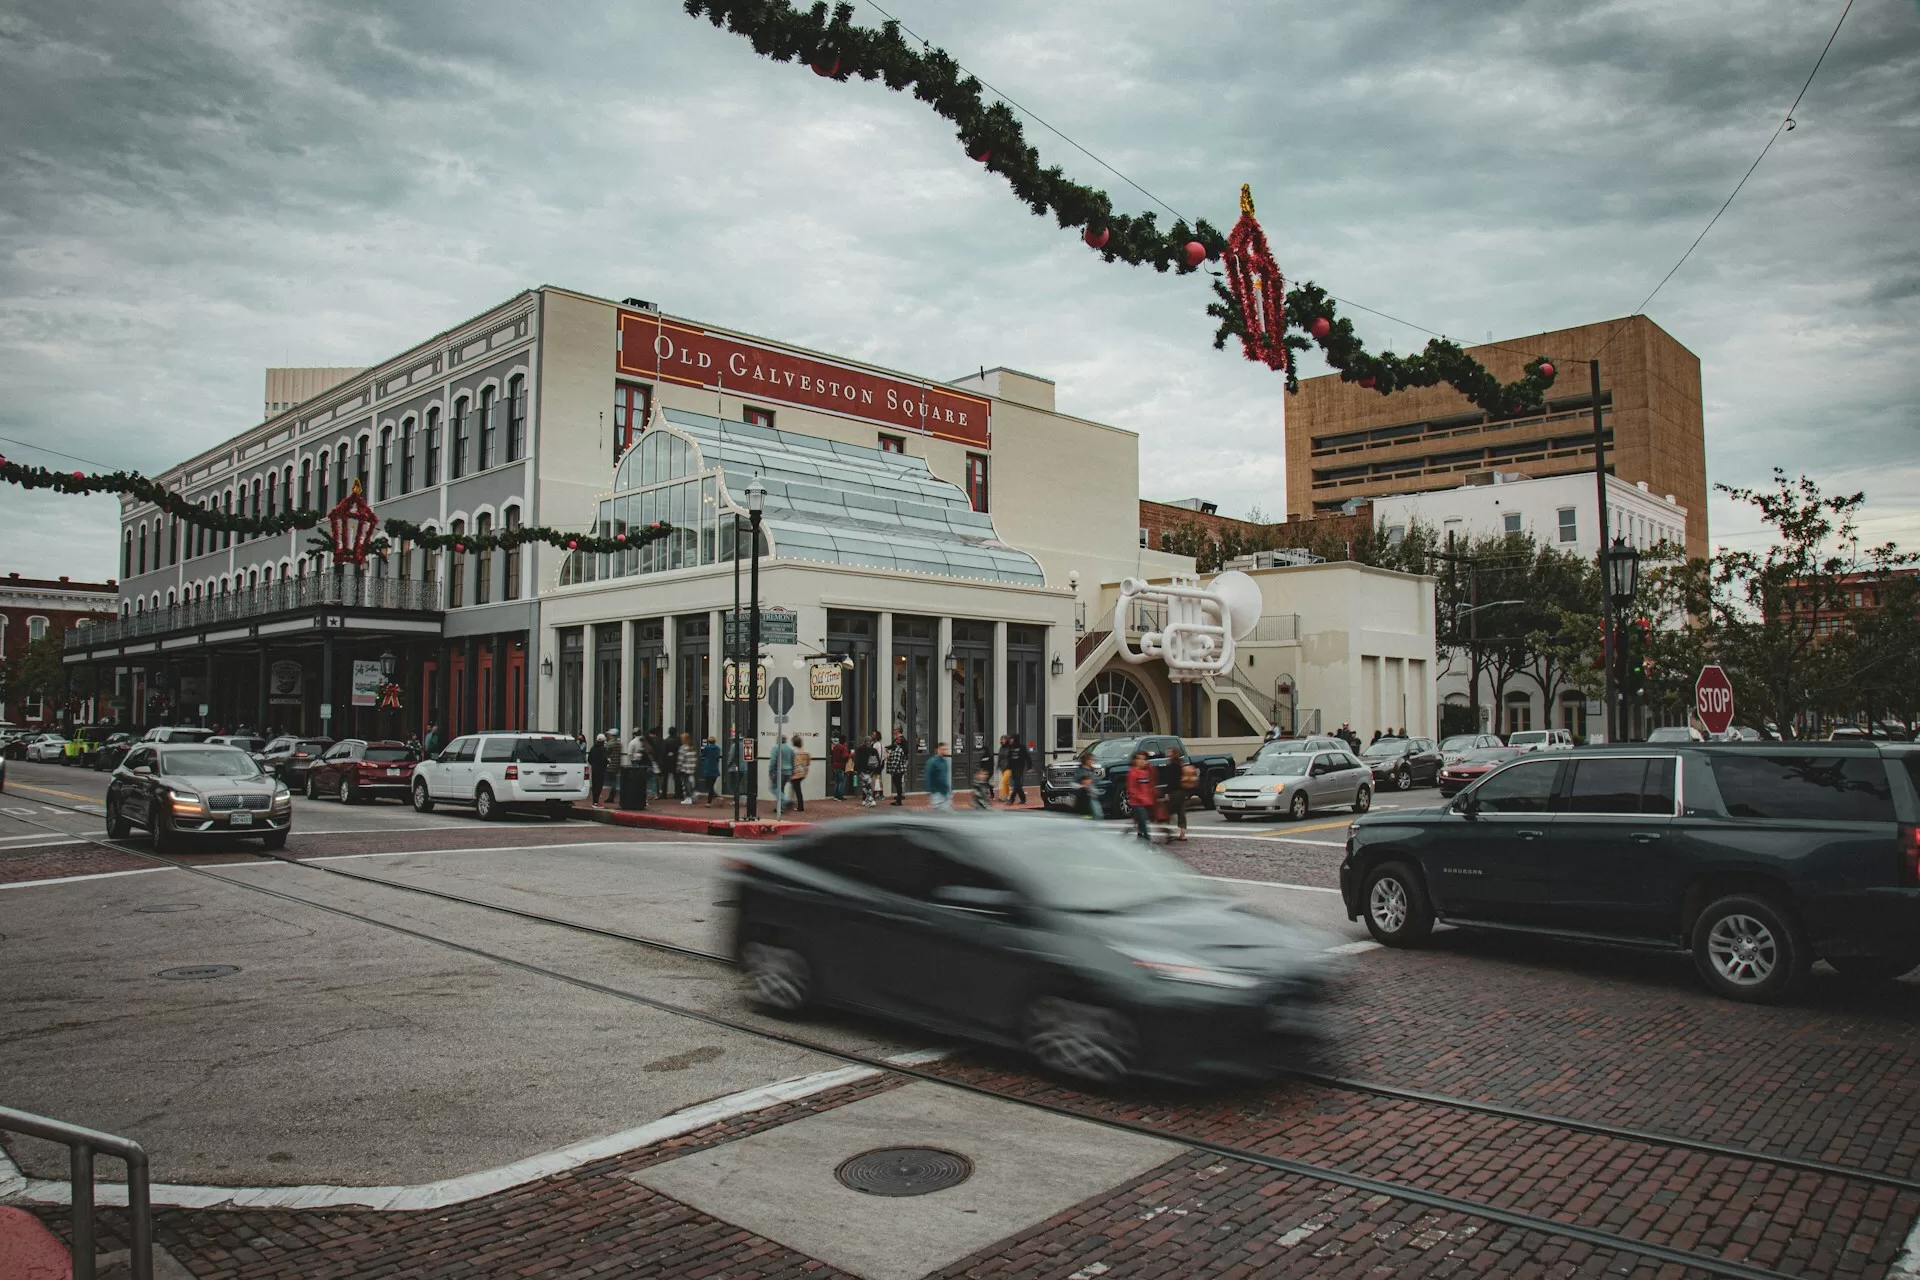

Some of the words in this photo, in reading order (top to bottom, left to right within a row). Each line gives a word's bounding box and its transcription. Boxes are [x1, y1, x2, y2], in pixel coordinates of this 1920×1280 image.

[653, 335, 712, 369] OLD
[729, 352, 874, 405] GALVESTON
[886, 388, 969, 427] SQUARE
[762, 613, 794, 621] TREMONT
[812, 670, 826, 685] Old
[825, 669, 840, 683] Time
[729, 684, 763, 696] PHOO
[813, 684, 840, 696] PHOTO
[1699, 687, 1731, 713] STOP
